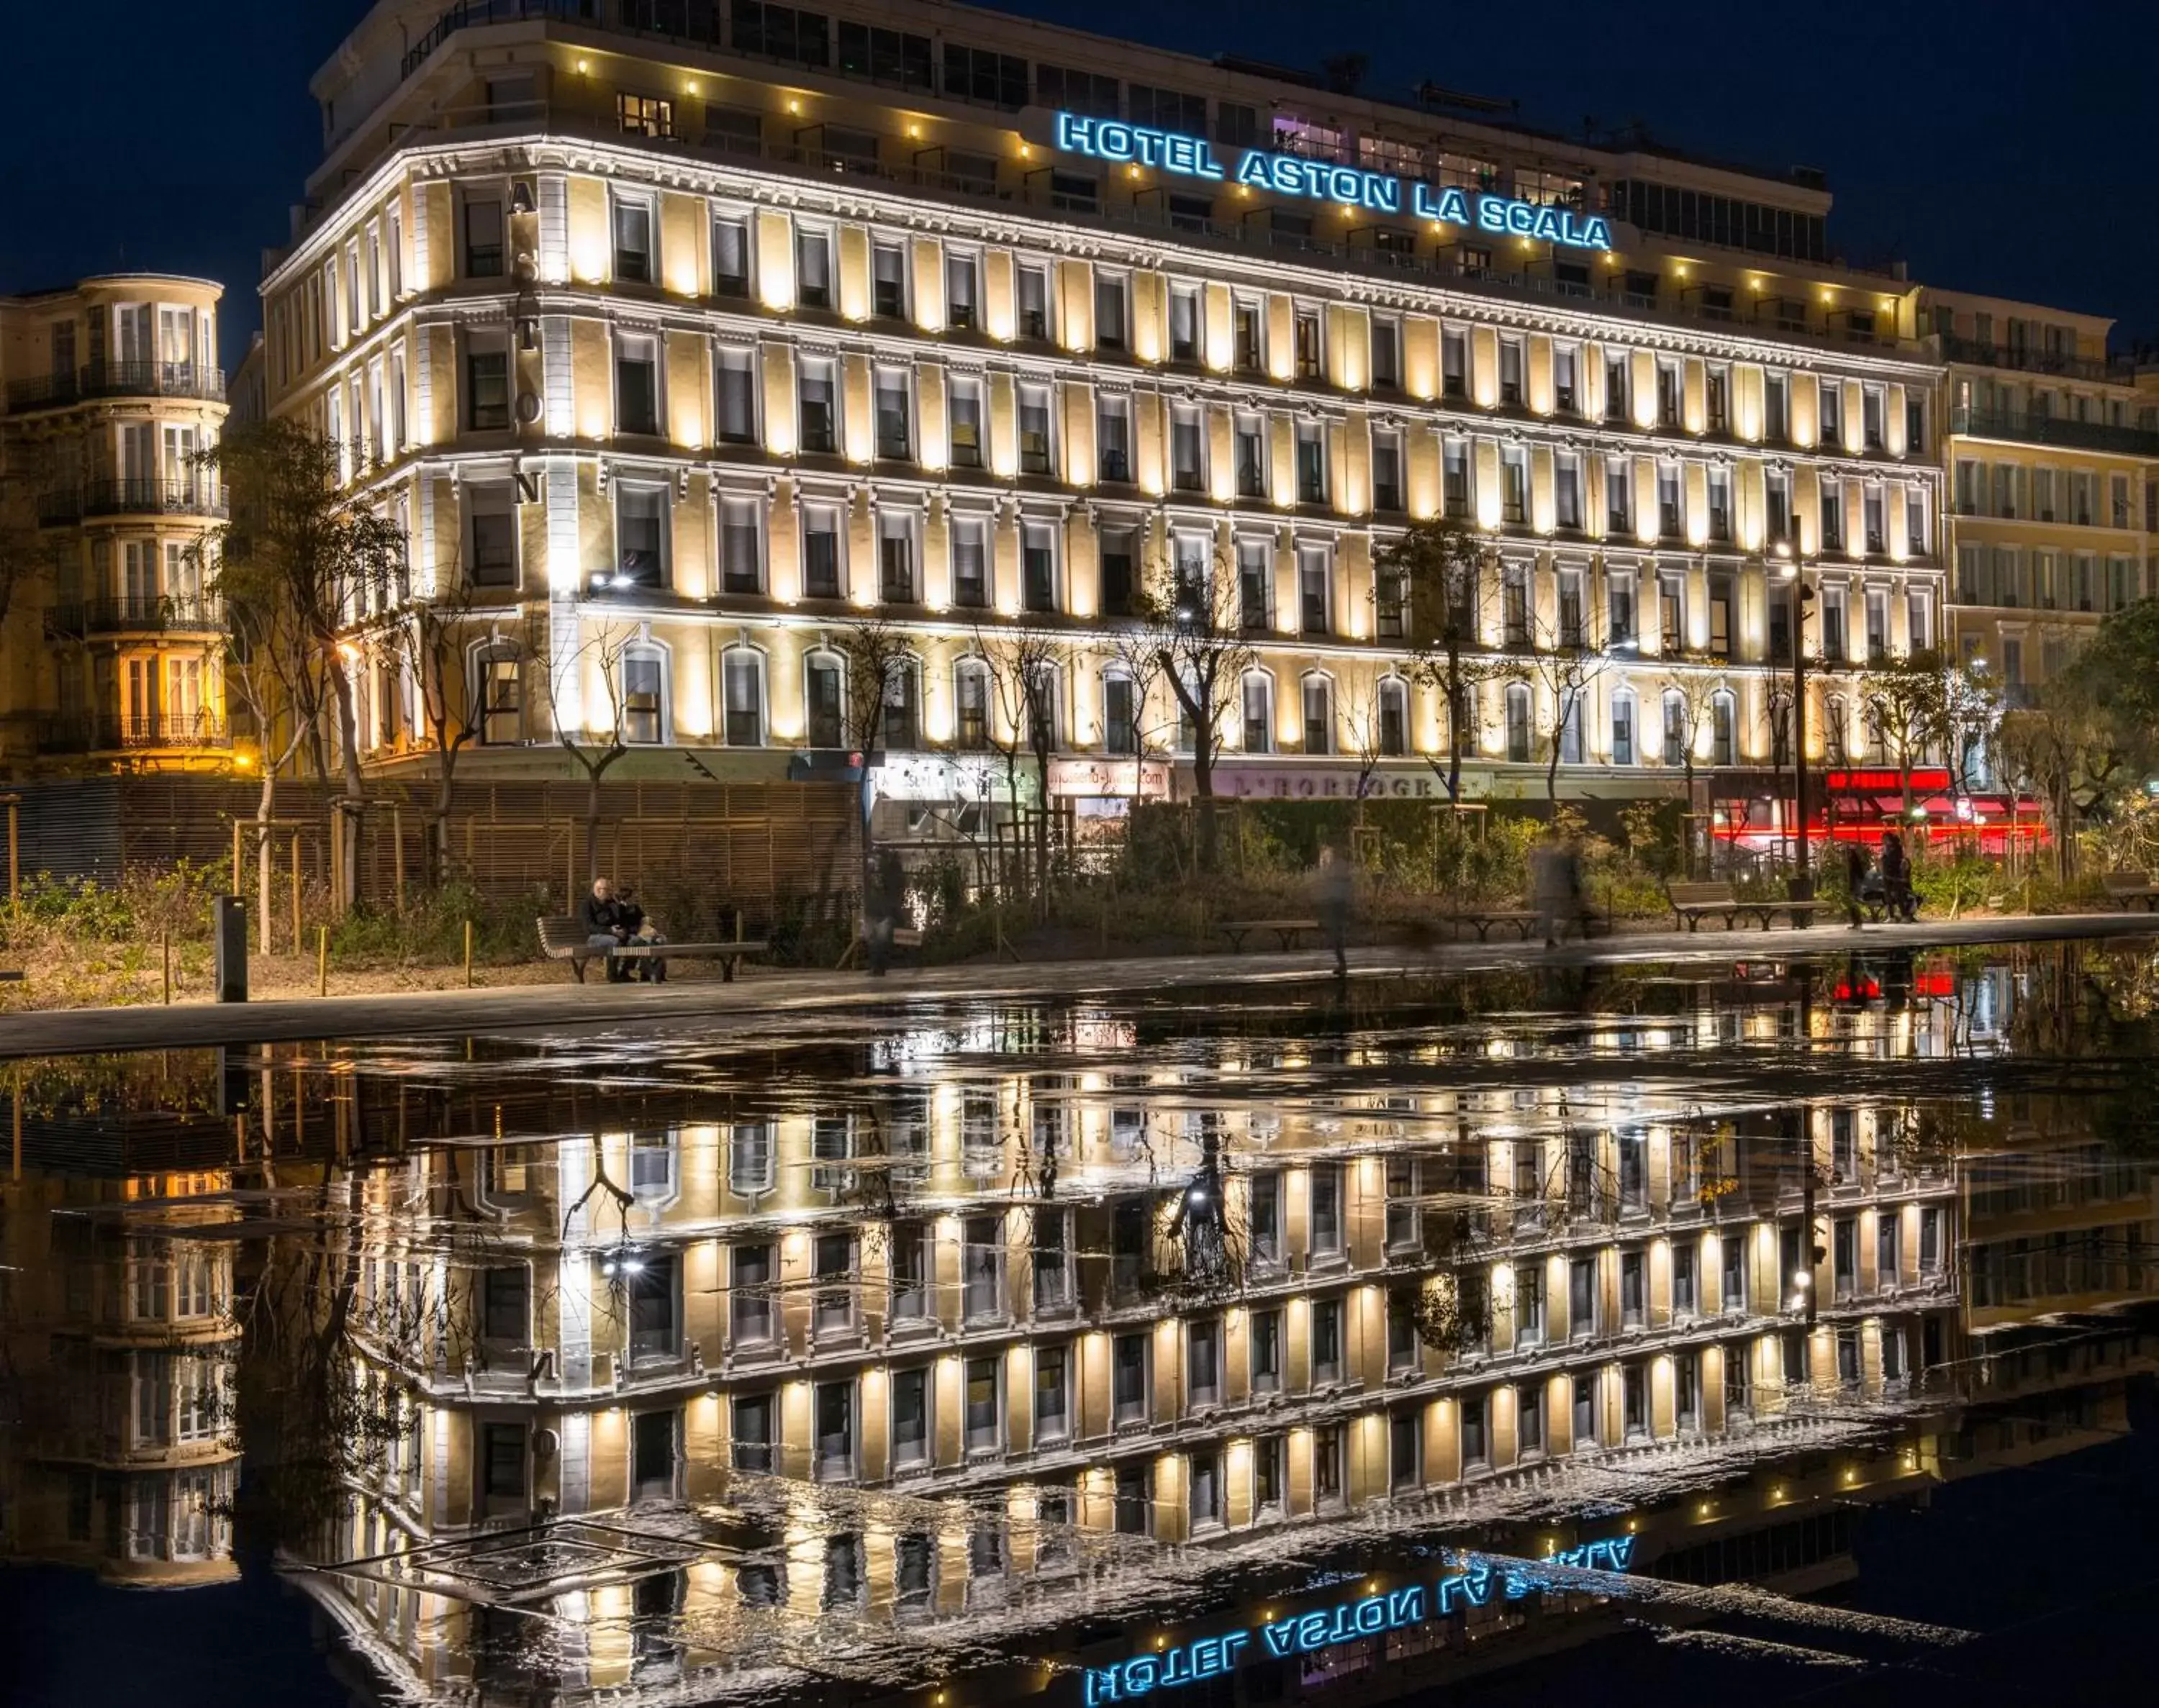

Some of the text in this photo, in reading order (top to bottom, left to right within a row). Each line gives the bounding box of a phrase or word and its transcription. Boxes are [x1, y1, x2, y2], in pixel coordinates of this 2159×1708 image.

[1059, 113, 1612, 250] HOTEL ASTON LA SCALA
